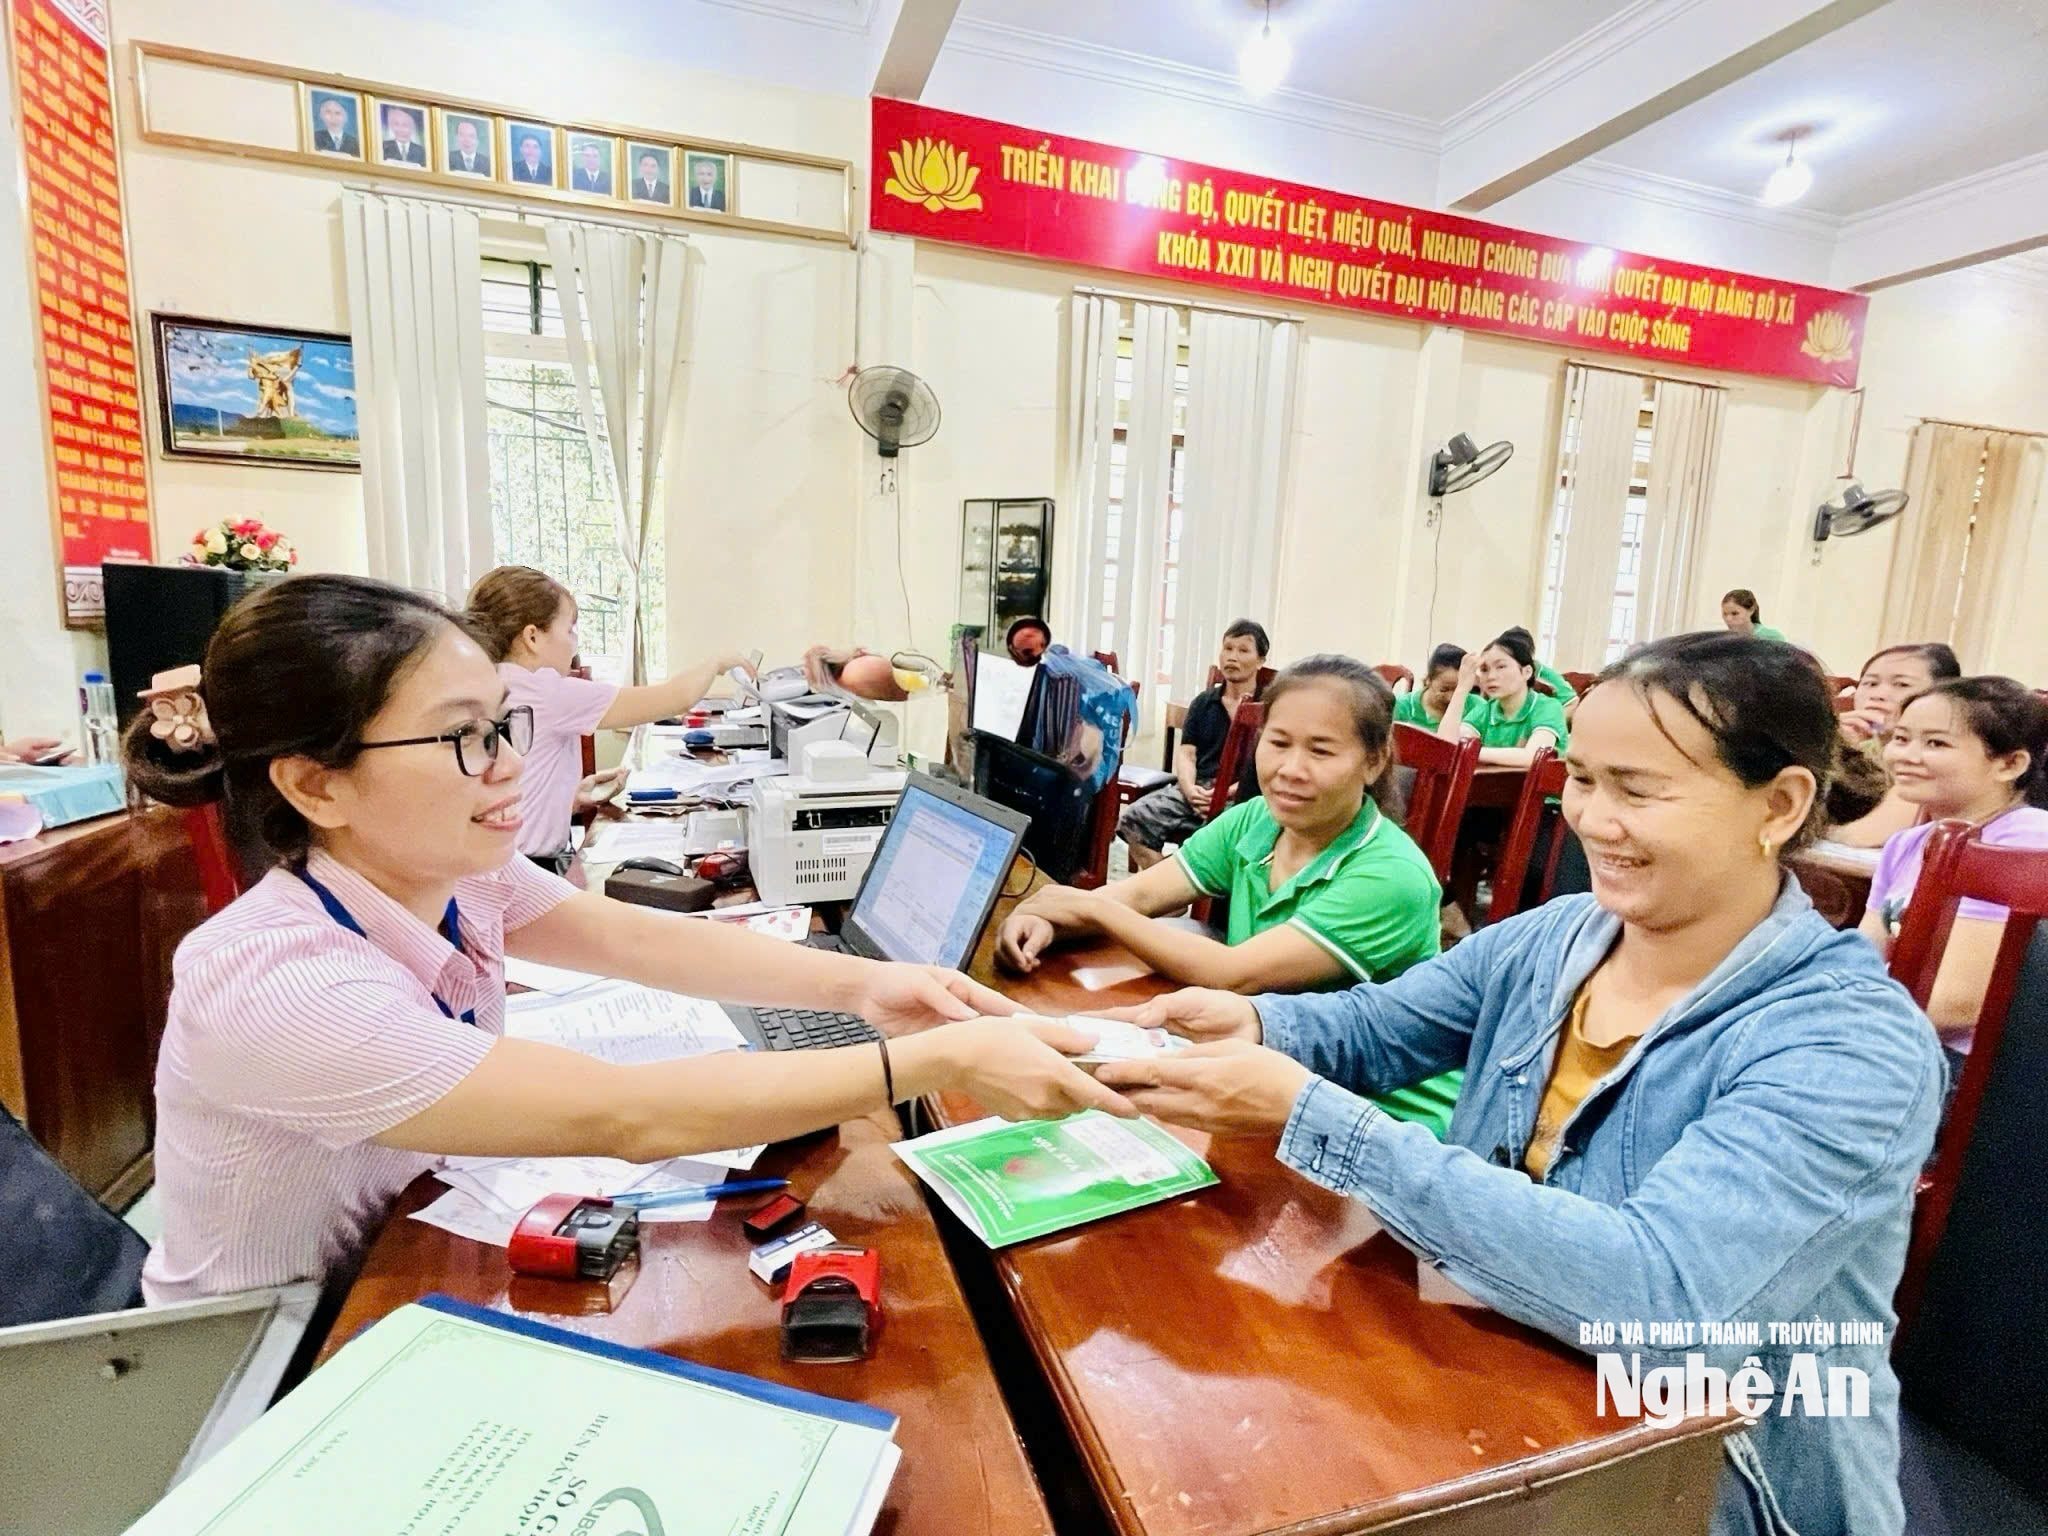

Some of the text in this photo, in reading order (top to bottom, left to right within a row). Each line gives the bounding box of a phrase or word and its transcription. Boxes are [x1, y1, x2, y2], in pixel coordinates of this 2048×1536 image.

[1001, 139, 1065, 191] TRIỂN
[1070, 159, 1120, 201] KHAI
[1187, 177, 1219, 227] BỘ,
[1224, 188, 1285, 232] QUYẾT
[1288, 199, 1328, 245] LIỆT,
[1332, 207, 1375, 253] HIỆU
[1377, 215, 1417, 261] QUẢ,
[1421, 229, 1481, 269] NHANH
[1483, 240, 1538, 281] CHÓNG
[1614, 264, 1662, 302] QUYẾT
[1661, 275, 1689, 313] ĐẠI
[1688, 277, 1715, 317] HỘI
[1715, 279, 1754, 320] ĐẢNG
[1755, 289, 1776, 328] BỘ
[1157, 230, 1692, 352] KHÓA XXII VÀ NGHỊ QUYẾT ĐẠI HỘI ĐẢNG CÁC CẤP VÀO CUỘC SỐNG
